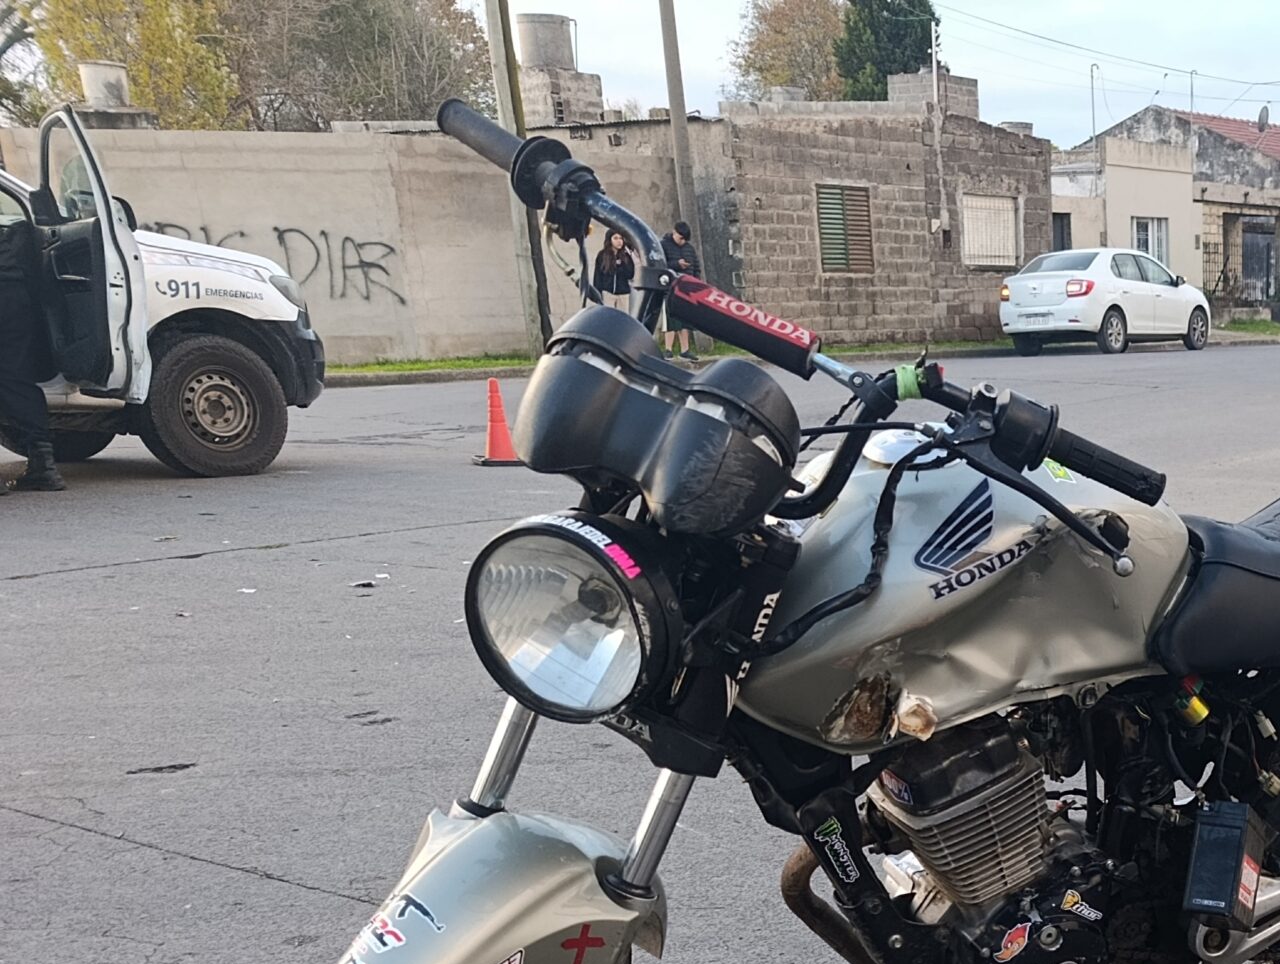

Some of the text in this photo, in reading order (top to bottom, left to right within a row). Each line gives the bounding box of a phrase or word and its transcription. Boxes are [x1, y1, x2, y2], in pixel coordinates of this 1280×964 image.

[167, 279, 264, 300] 911 EMERGENCIAS
[704, 289, 811, 345] HONDA
[928, 539, 1034, 600] HONDA
[736, 590, 782, 680] HNDA
[831, 835, 858, 880] MONSTER
